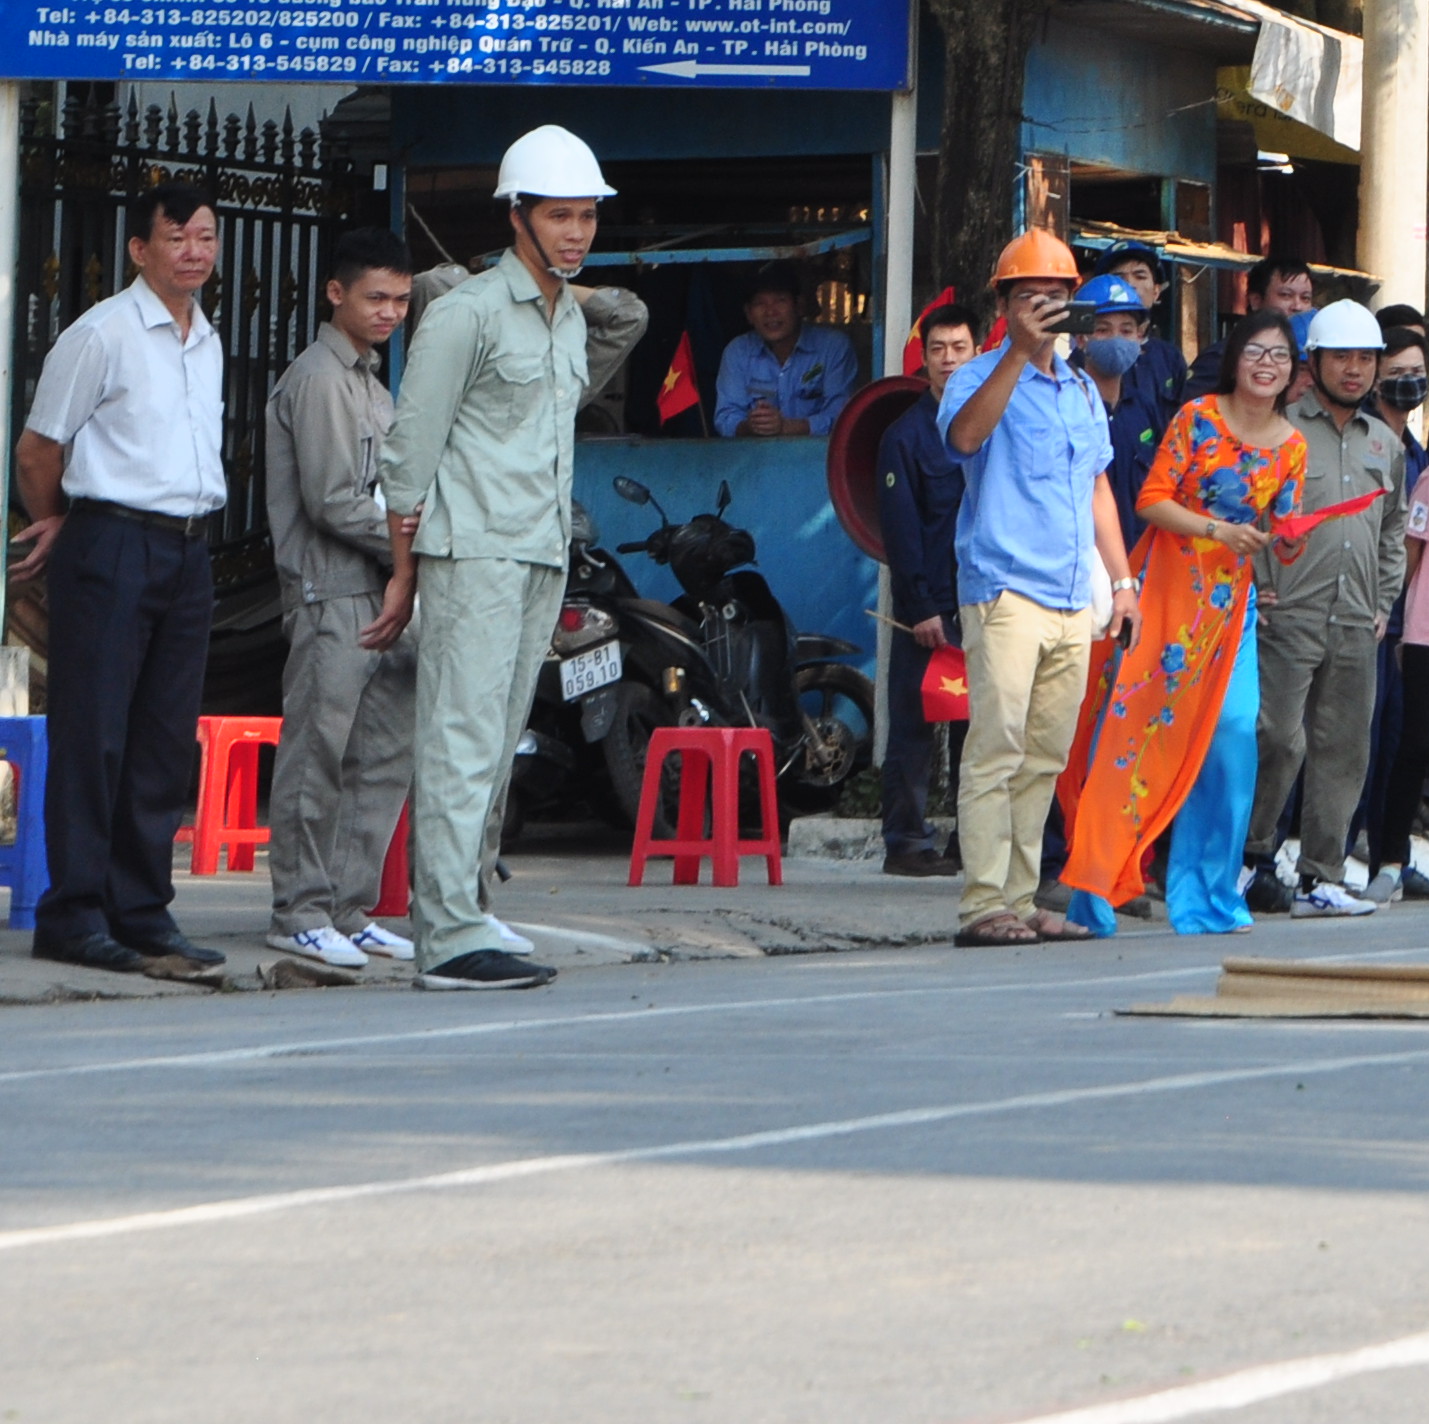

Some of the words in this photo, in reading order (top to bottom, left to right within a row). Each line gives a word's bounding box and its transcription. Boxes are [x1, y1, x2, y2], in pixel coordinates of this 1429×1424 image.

[36, 7, 76, 24] Tel:
[379, 12, 422, 28] Fax:
[628, 16, 679, 32] Web:
[28, 30, 70, 47] Nhà
[76, 31, 120, 50] máy
[125, 30, 163, 48] sản
[169, 30, 222, 48] xuất:
[229, 32, 253, 48] Lô
[259, 33, 273, 48] 6
[296, 37, 339, 53] cụm
[346, 34, 396, 53] công
[403, 35, 473, 55] nghiệp
[479, 35, 532, 52] Quán
[595, 38, 616, 54] Q.
[622, 36, 667, 54] Kiến
[673, 39, 699, 55] An
[765, 39, 798, 57] Hải
[805, 41, 867, 60] Phòng
[123, 54, 162, 70] Tel:
[377, 56, 420, 73] Fax:
[570, 646, 610, 675] 15-B1
[566, 661, 618, 695] 059.10
